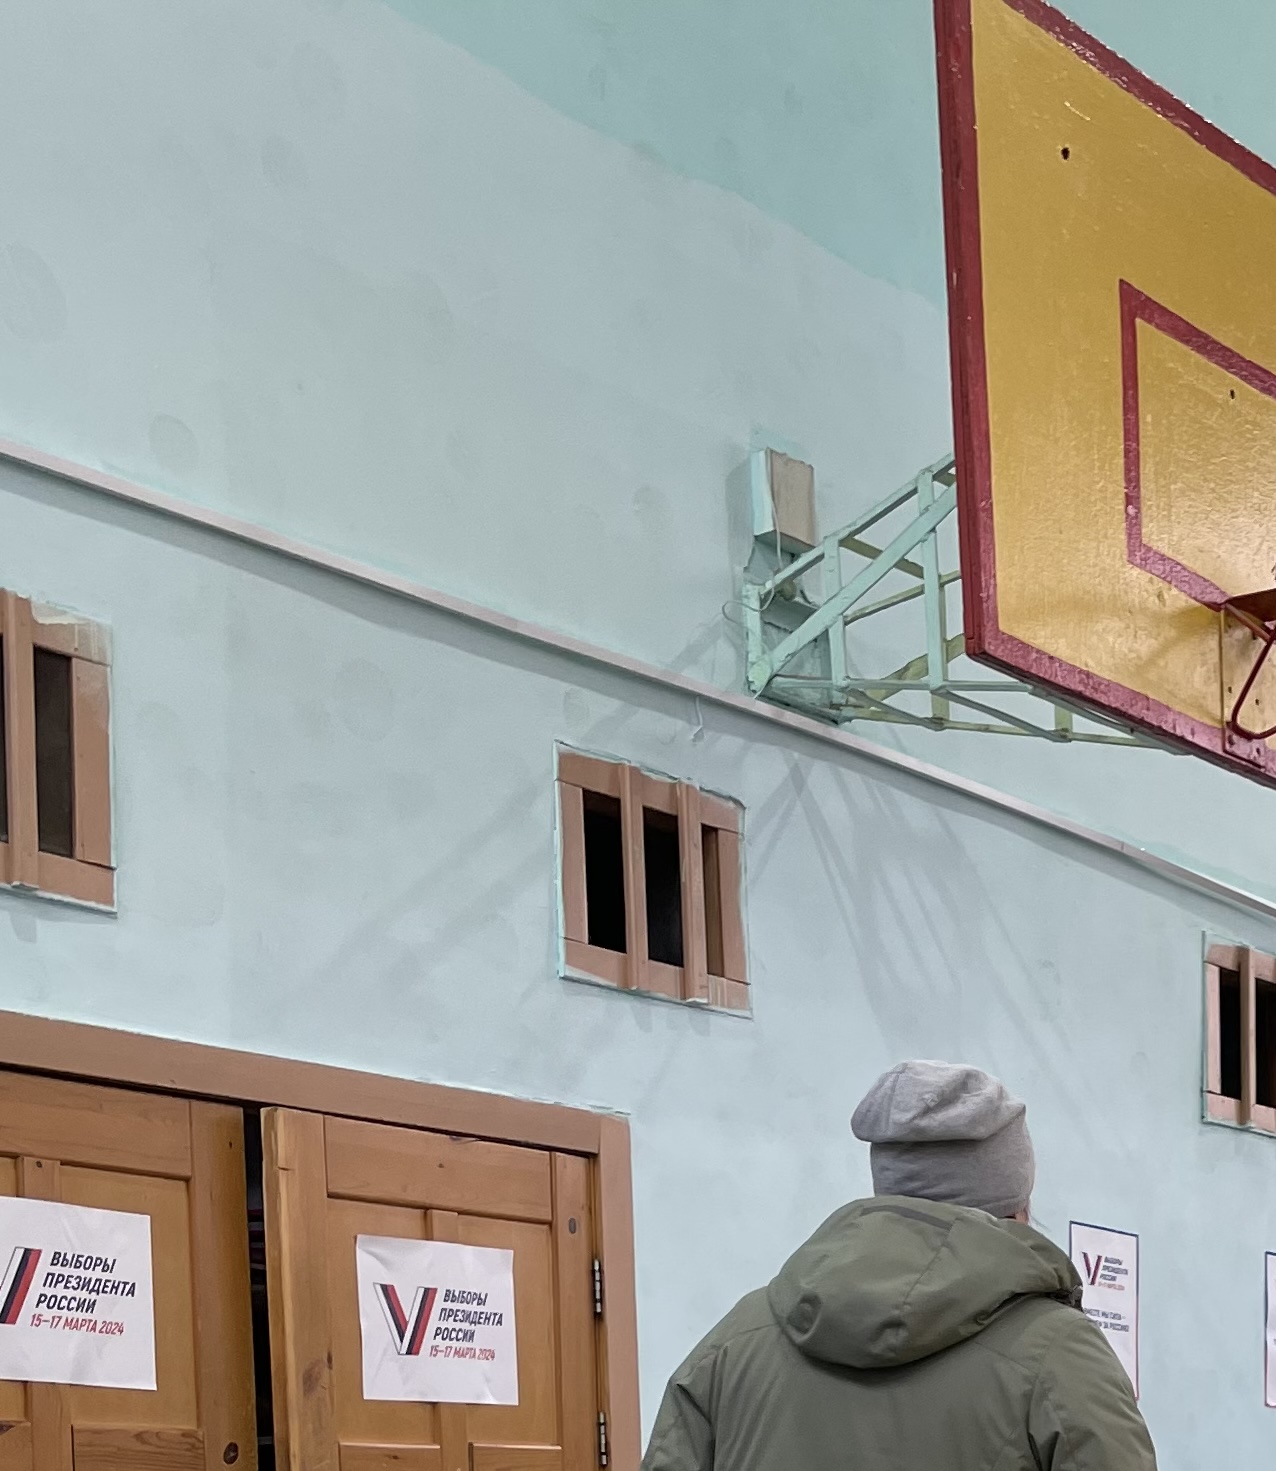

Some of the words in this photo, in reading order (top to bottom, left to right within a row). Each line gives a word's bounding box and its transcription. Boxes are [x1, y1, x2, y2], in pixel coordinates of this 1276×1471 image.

[50, 1251, 117, 1274] ВЫБОРЫ
[42, 1272, 136, 1298] ПРЕЗИДЕНТА
[35, 1293, 97, 1314] РОССИИ
[443, 1289, 488, 1307] ВЫБОРЫ
[63, 1316, 97, 1333] МАРТА
[98, 1320, 124, 1336] 2024
[438, 1307, 503, 1327] ПРЕЗИДЕНТА
[433, 1327, 475, 1343] РОССИИ
[453, 1346, 476, 1360] МАРТА
[477, 1349, 496, 1361] 2024
